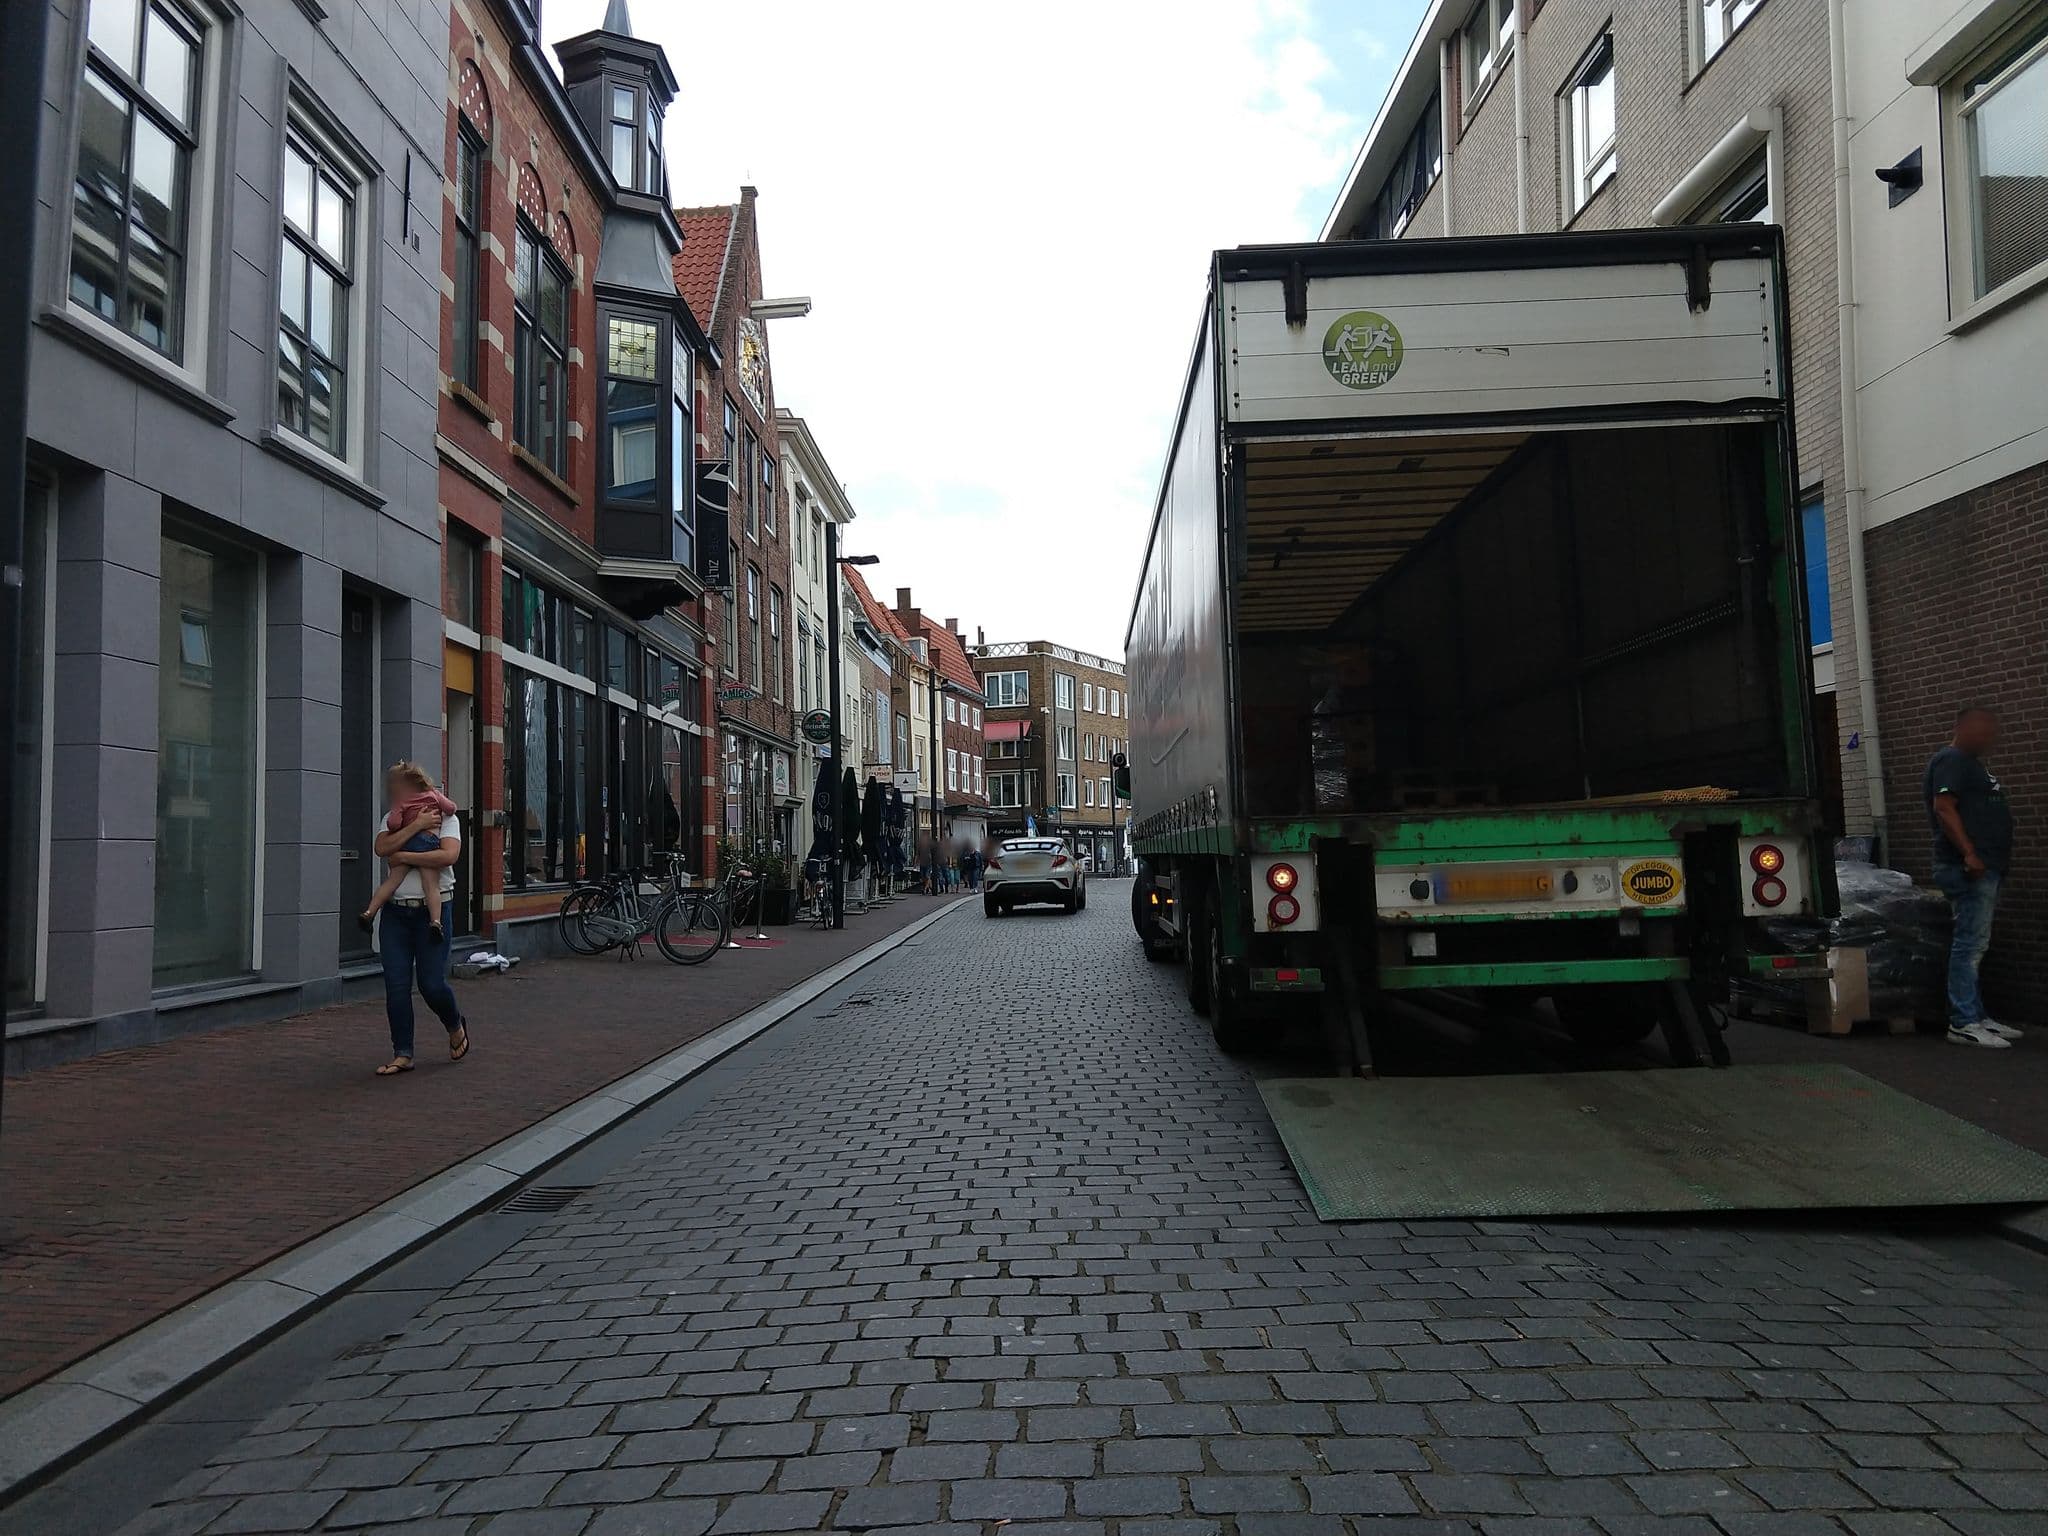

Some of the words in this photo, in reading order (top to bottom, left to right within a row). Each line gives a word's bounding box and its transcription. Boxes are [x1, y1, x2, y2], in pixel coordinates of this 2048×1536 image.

[1332, 361, 1369, 373] LEAN
[1372, 360, 1397, 371] and
[1341, 372, 1388, 384] GREEN
[723, 688, 750, 698] AMIGO
[1630, 862, 1673, 874] OPLEGGER
[1632, 876, 1671, 889] JUMBO
[1631, 891, 1674, 905] HELMOND
